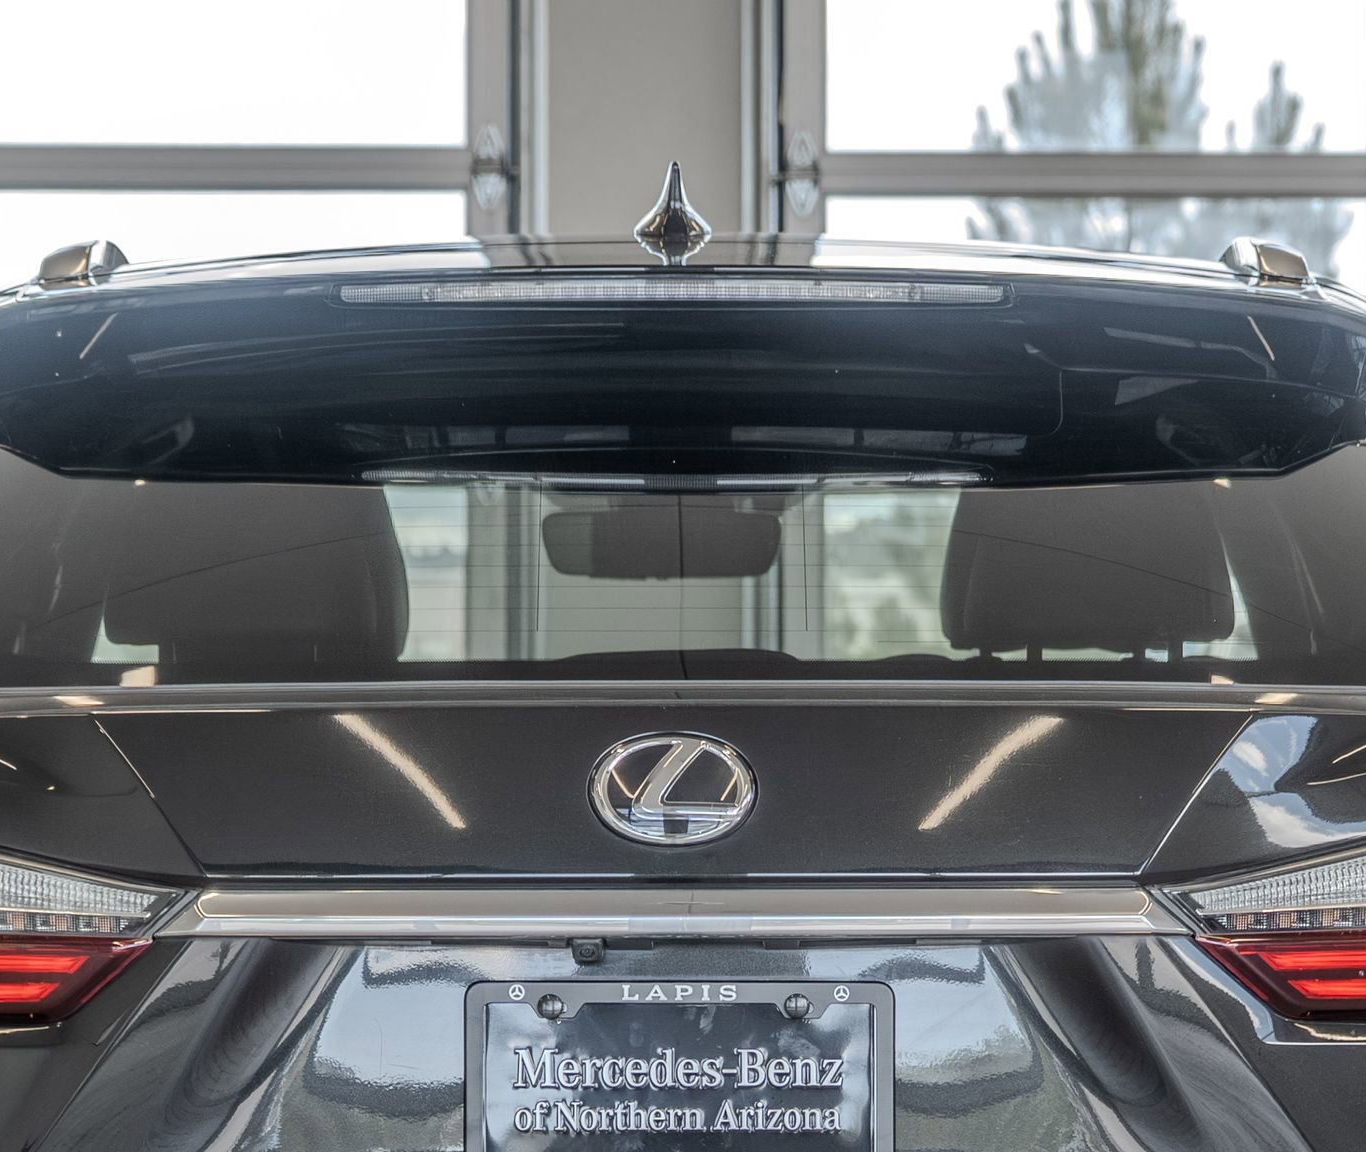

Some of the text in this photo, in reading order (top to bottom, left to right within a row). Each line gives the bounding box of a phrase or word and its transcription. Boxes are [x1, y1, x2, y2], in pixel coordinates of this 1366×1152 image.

[622, 984, 738, 1001] LAPIS
[514, 1047, 844, 1090] Mercedes-Benz
[513, 1101, 842, 1133] of Northern Arizona
